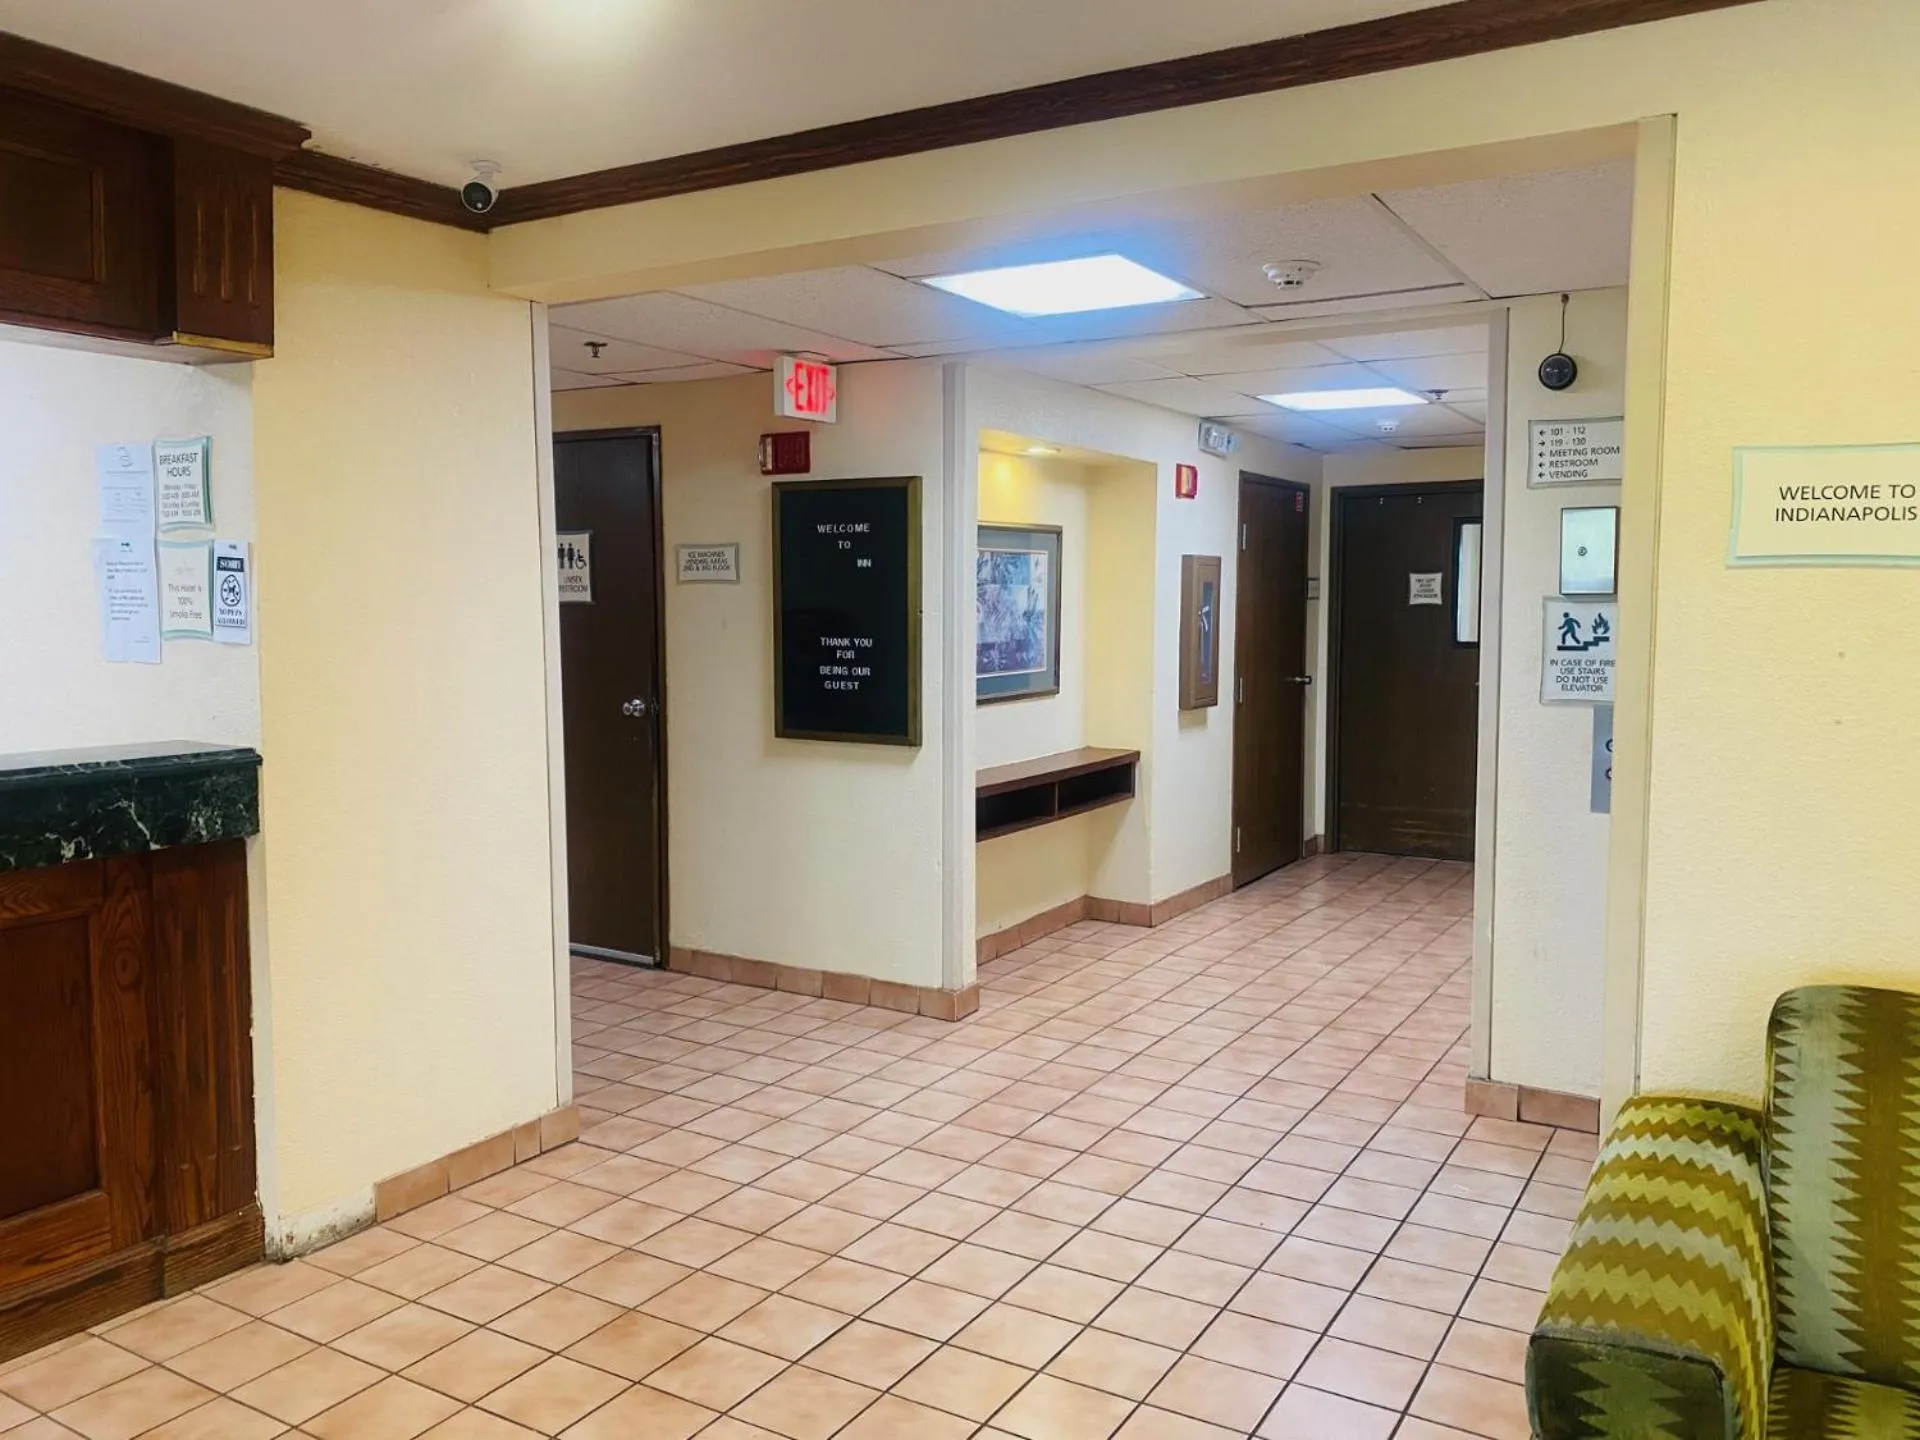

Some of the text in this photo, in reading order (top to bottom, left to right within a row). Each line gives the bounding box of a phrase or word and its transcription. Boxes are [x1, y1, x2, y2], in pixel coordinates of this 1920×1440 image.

[794, 361, 830, 415] EXIT
[1550, 427, 1564, 436] 101
[1573, 426, 1586, 435] 112
[1572, 437, 1587, 446] 130
[1549, 445, 1620, 457] MEETING ROOM
[159, 452, 199, 466] BREAKFAST
[1549, 458, 1598, 468] RESTROOM
[167, 466, 191, 478] HOURS
[1549, 469, 1588, 479] VENDING
[1778, 484, 1916, 501] WELCOME TO
[1775, 506, 1918, 522] INDIANAPOLIS
[817, 523, 871, 534] WELCOME
[837, 540, 851, 550] TO
[820, 636, 873, 647] THANK YOU
[836, 650, 855, 659] FOR
[1560, 659, 1581, 667] CASE
[819, 666, 871, 676] BEING OUR
[1560, 667, 1606, 676] USE STAIRS
[1556, 675, 1609, 684] DO NOT USE
[824, 680, 860, 690] GUEST
[1561, 684, 1604, 692] ELEVATOR
